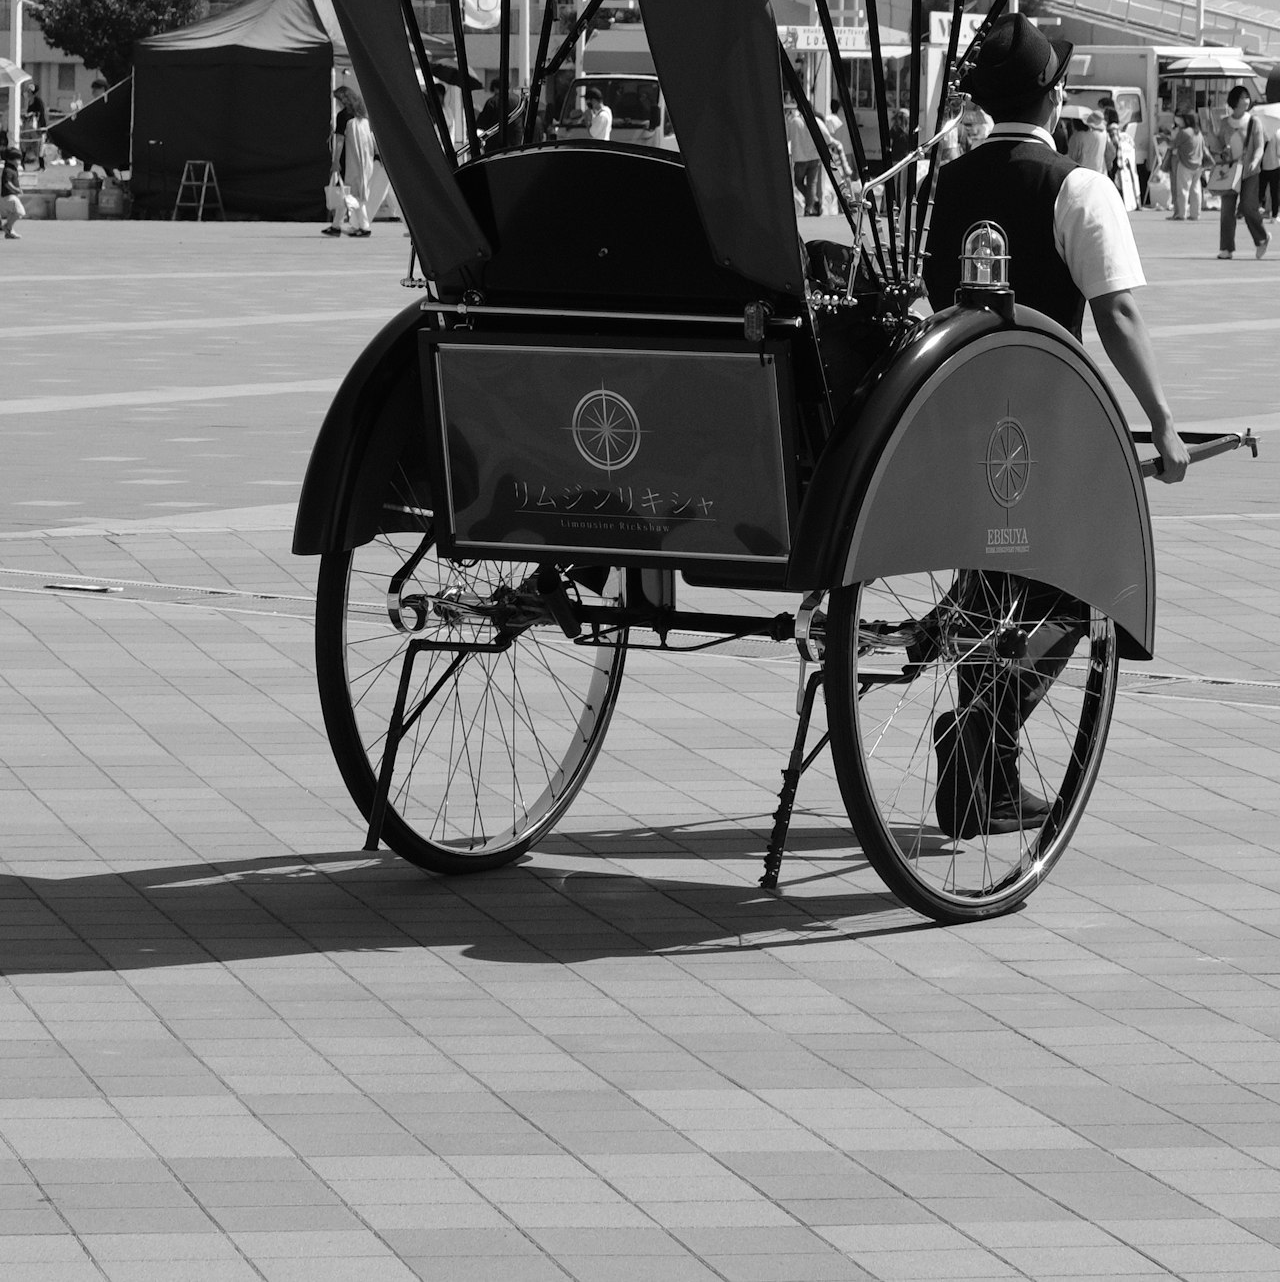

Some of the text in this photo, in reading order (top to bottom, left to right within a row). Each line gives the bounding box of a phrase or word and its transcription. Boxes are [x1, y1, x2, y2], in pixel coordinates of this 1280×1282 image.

[515, 481, 714, 515] リムジンリキシャ
[560, 519, 670, 532] Limousine Rickshaw
[987, 528, 1029, 545] EBISUYA
